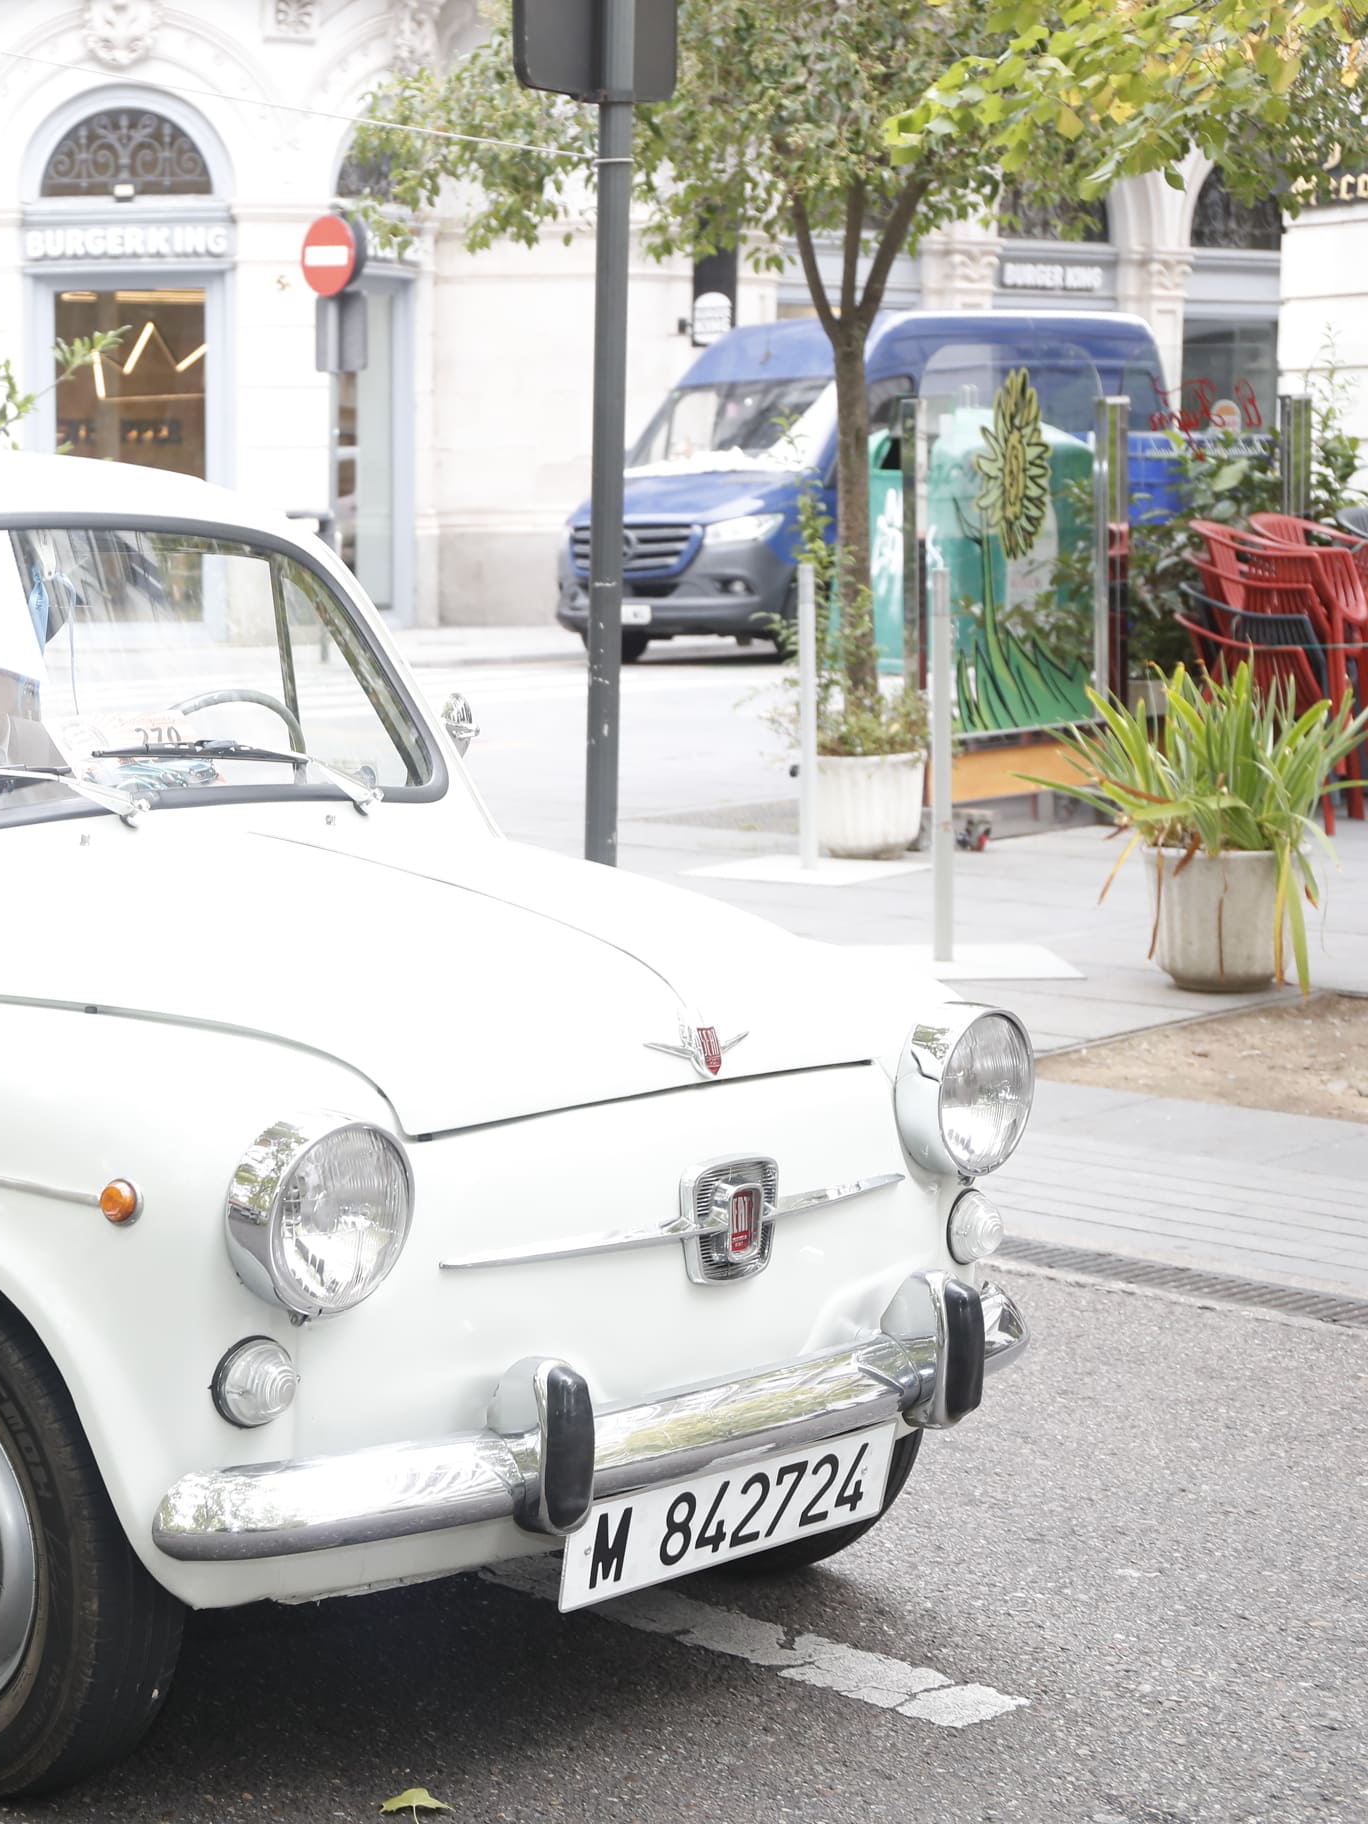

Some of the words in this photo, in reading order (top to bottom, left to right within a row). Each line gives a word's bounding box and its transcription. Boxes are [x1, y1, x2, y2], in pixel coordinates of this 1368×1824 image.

[25, 227, 145, 259] BURGER
[146, 224, 228, 256] KING
[589, 1507, 633, 1590] M
[659, 1442, 870, 1566] 842724
